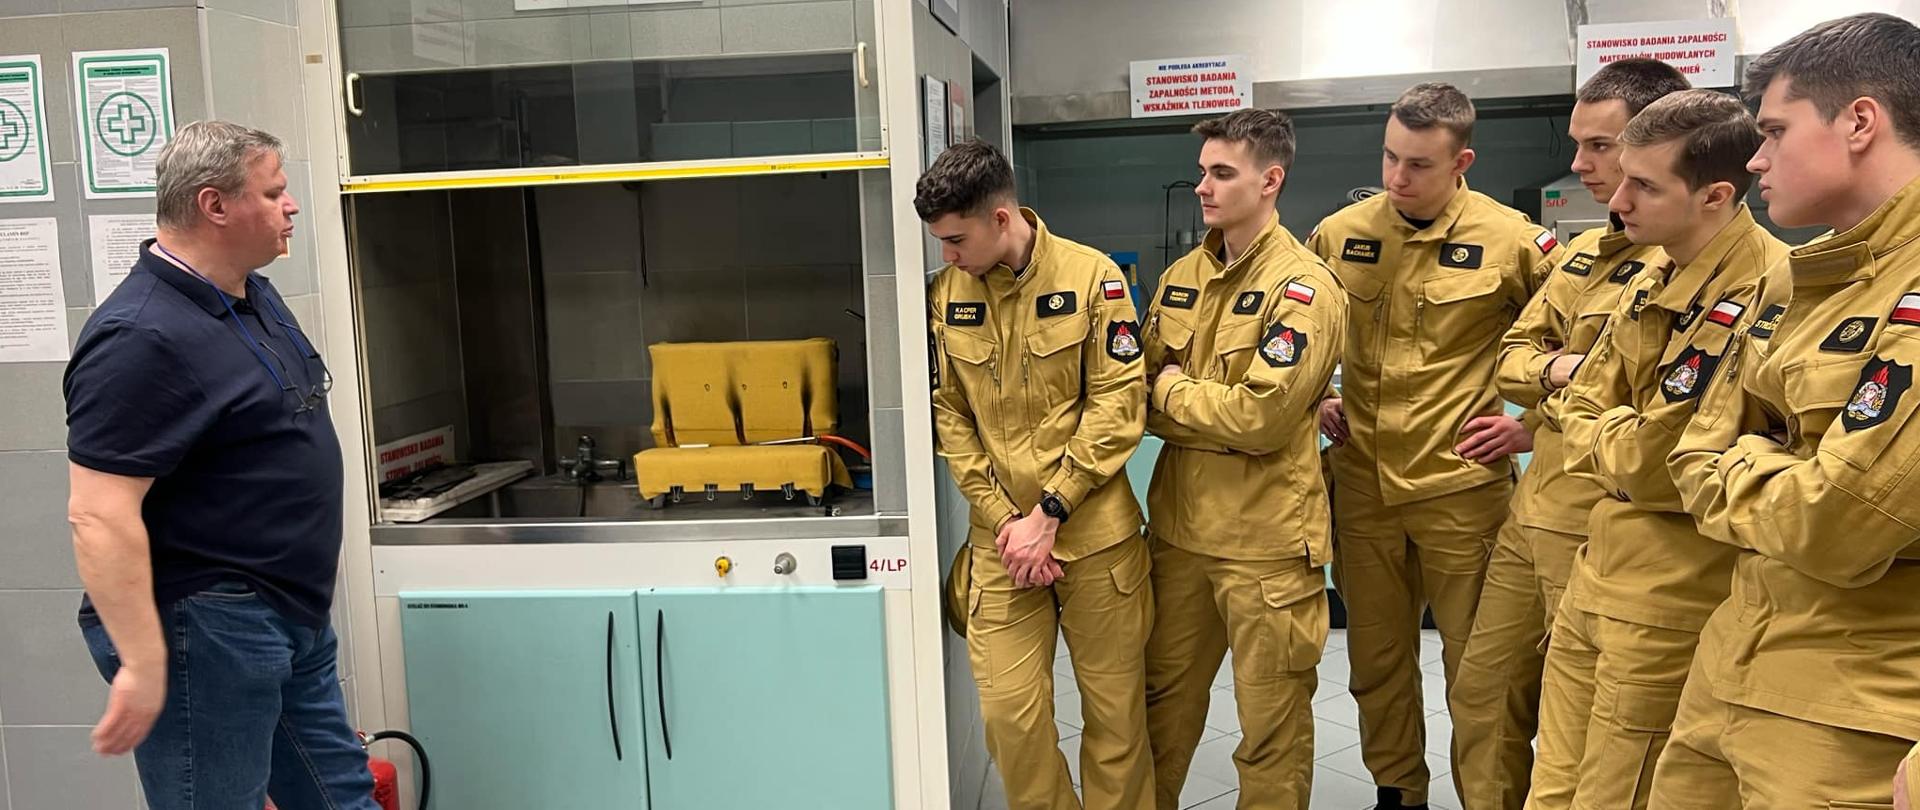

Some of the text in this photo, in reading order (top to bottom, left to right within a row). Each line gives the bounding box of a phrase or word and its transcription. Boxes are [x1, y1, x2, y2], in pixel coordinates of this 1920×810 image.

[1587, 32, 1727, 49] STANOWISKO BADANIA ZAPALNOŚCI
[1146, 71, 1236, 86] STANOWISKO BADANIA
[1149, 85, 1234, 99] ZAPALNOŚCI METODĄ
[1143, 98, 1241, 112] WSKAŹNIKA TLENOWEGO
[869, 559, 907, 572] 4/LP
